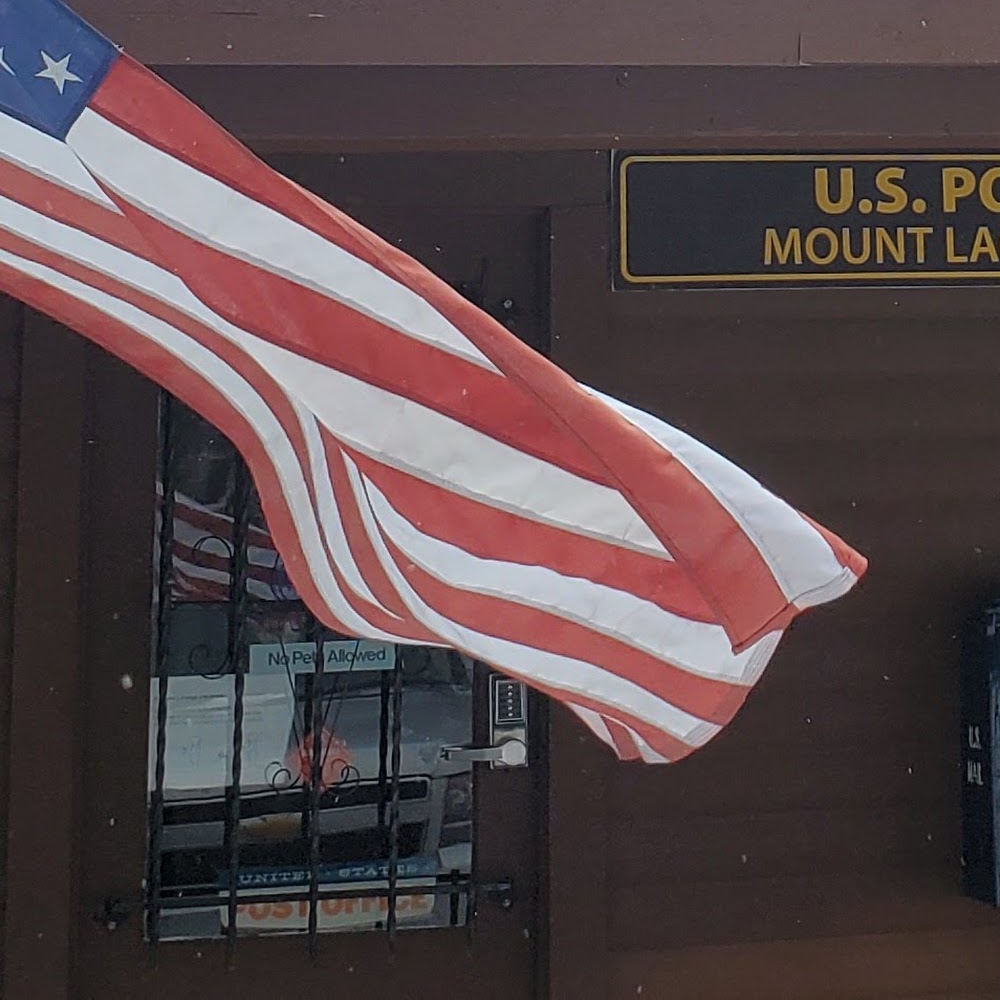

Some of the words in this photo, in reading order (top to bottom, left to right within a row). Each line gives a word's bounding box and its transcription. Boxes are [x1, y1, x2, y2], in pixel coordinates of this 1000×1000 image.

[814, 167, 927, 214] U.S.
[763, 226, 934, 265] MOUNT
[268, 652, 290, 666] No
[327, 647, 386, 663] Allowed
